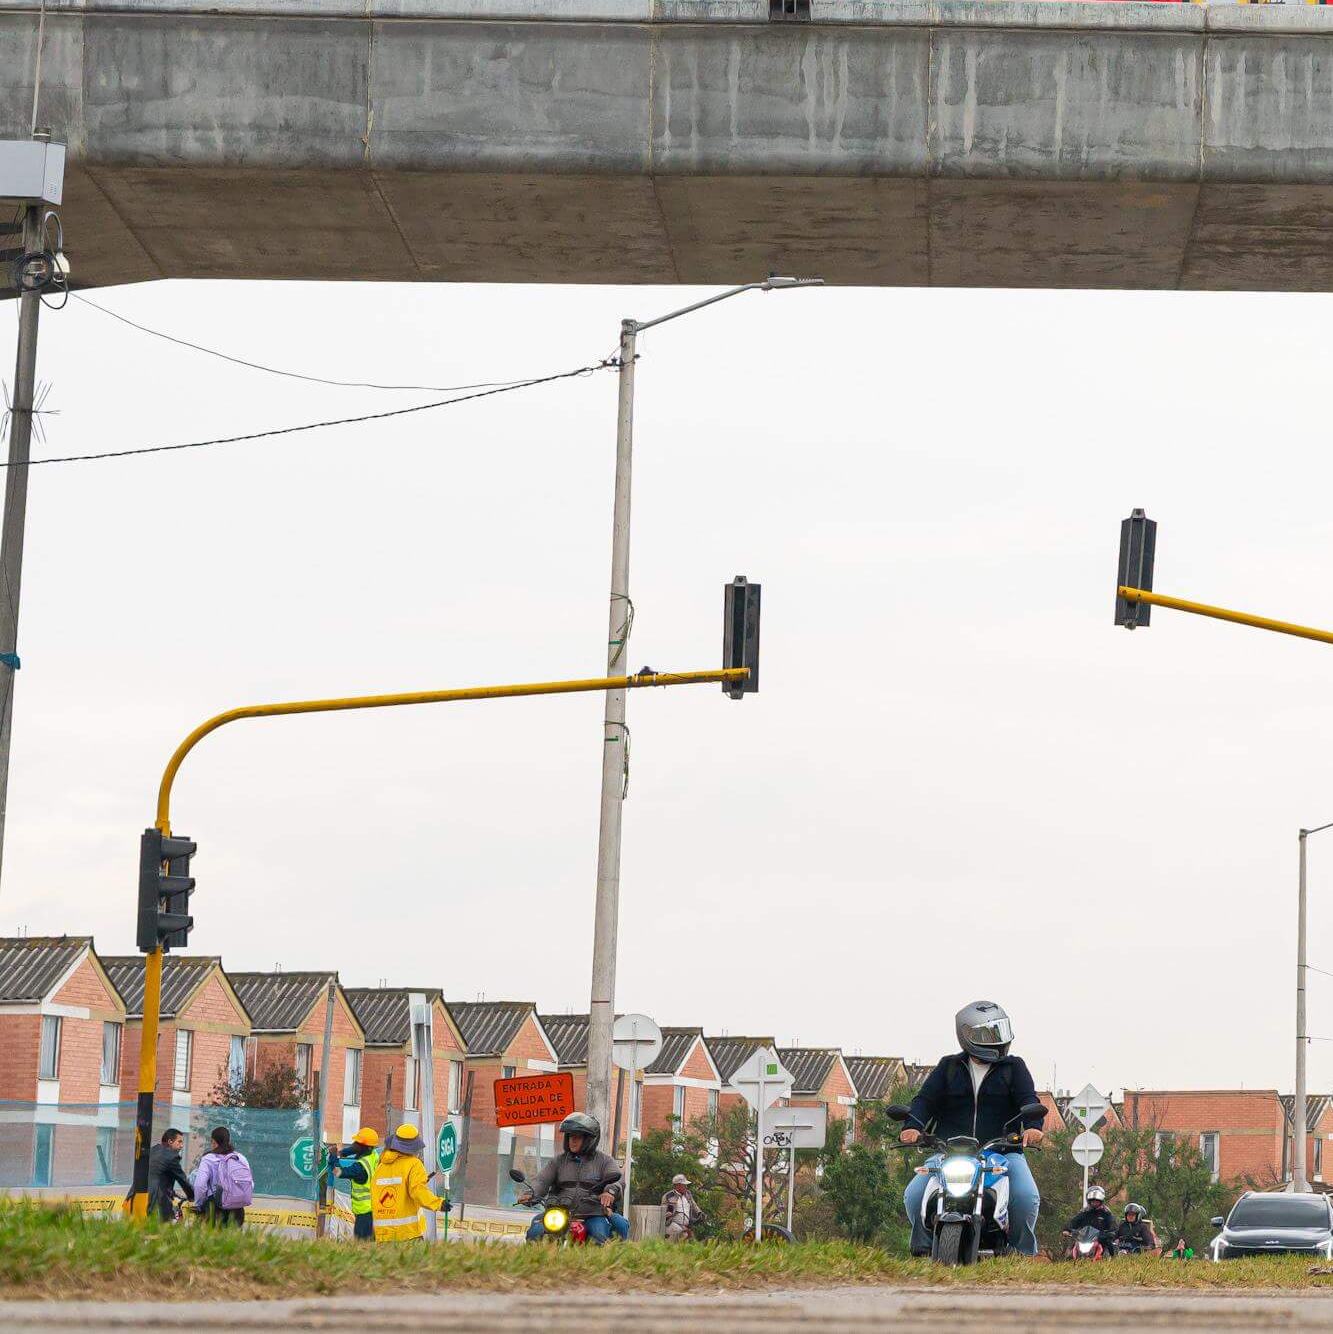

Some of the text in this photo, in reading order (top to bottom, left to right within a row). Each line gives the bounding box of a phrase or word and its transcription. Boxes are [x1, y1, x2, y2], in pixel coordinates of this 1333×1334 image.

[503, 1079, 566, 1093] ENTRADA Y
[506, 1093, 564, 1106] SALIDA DE
[504, 1106, 567, 1120] VOLQUETAS
[440, 1136, 454, 1158] SIGA
[302, 1144, 314, 1172] SIGA
